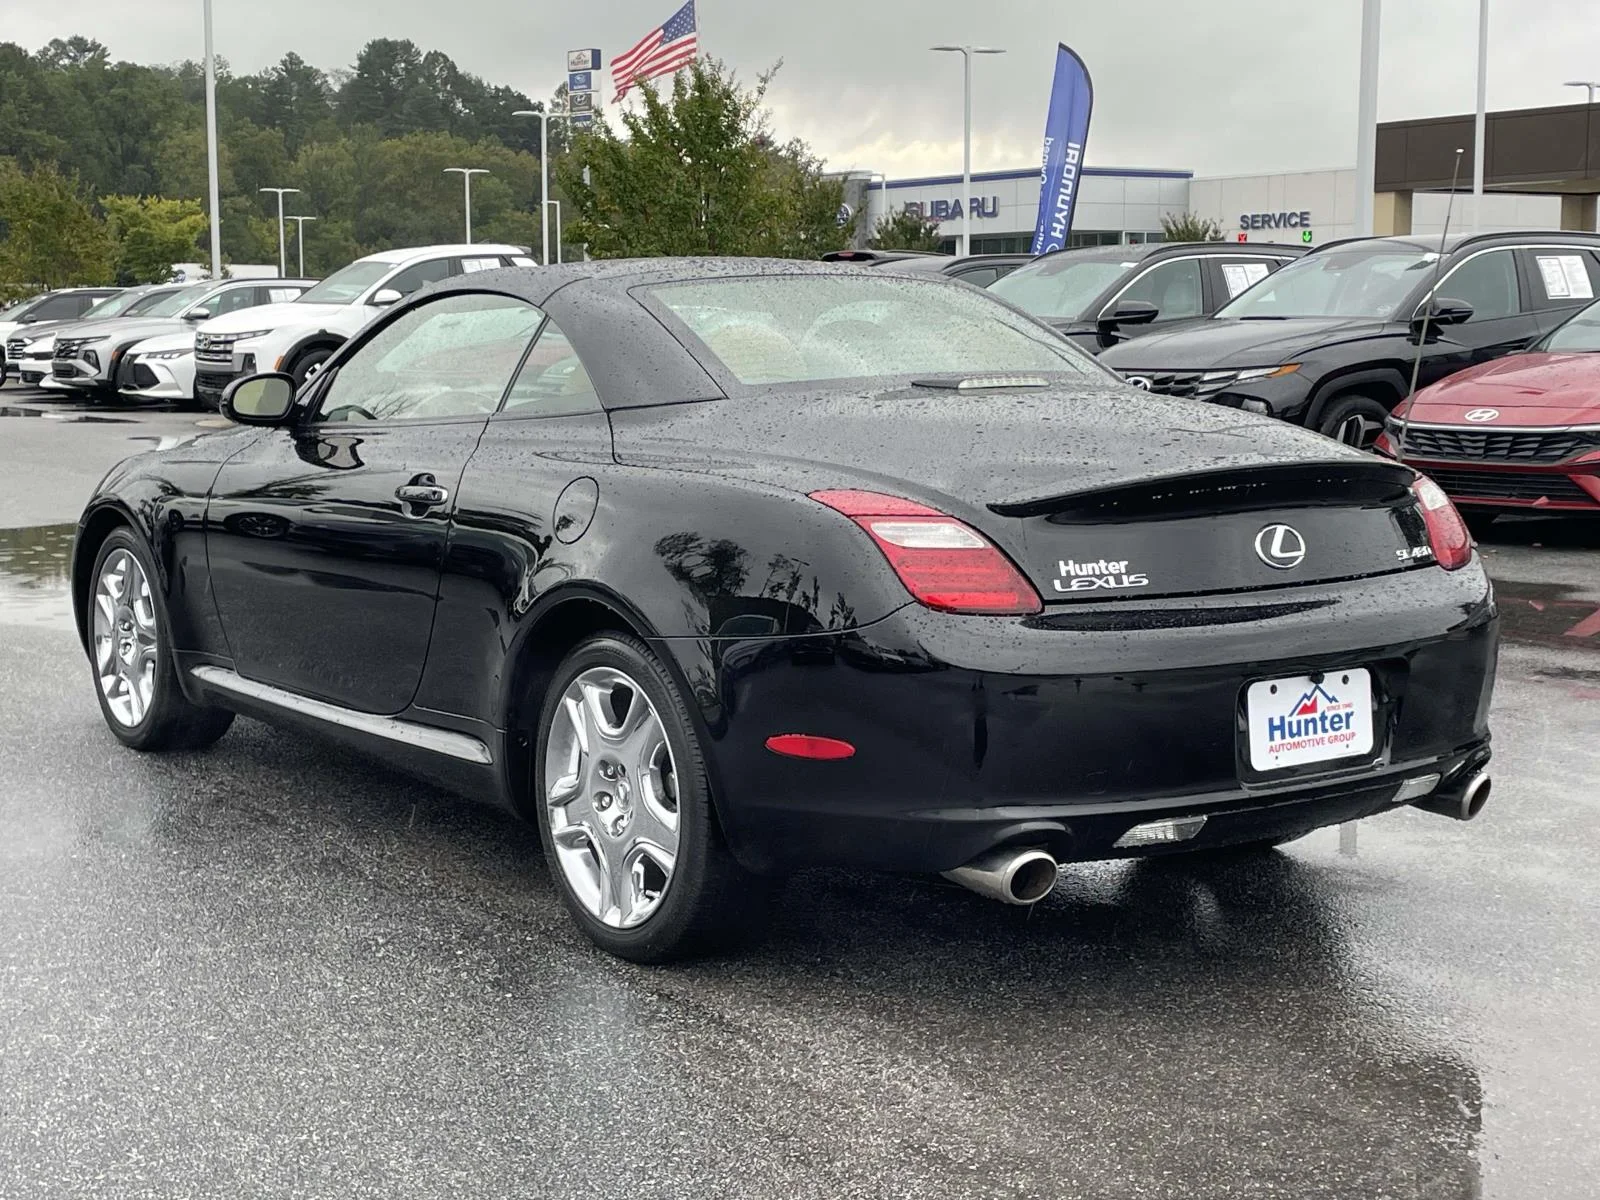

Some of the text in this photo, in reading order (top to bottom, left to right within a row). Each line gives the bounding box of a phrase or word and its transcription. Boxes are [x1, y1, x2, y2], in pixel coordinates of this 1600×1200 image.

[904, 196, 1000, 221] SUBARU
[1240, 211, 1311, 230] SERVICE
[1058, 559, 1129, 577] Hunter
[1053, 573, 1149, 592] LEXUS
[1268, 710, 1354, 742] Hunter
[1268, 737, 1326, 754] AUTOMOTIVE
[1328, 732, 1356, 744] GROUP
